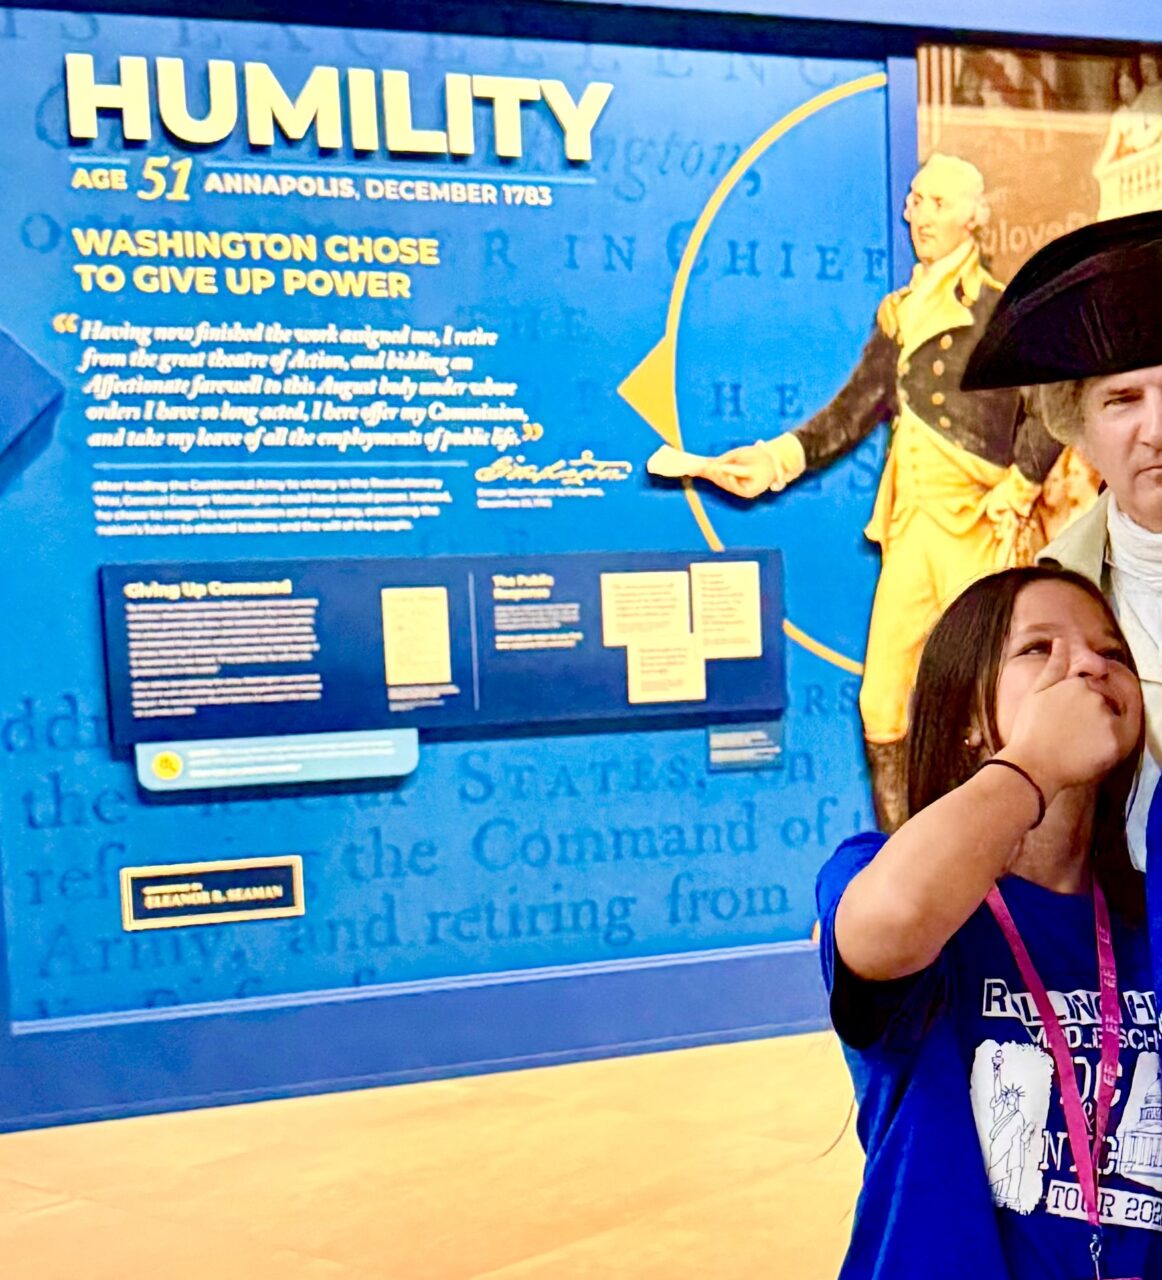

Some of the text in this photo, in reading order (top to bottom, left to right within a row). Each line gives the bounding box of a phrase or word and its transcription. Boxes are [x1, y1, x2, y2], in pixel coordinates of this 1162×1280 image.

[65, 53, 614, 161] HUMILITY
[72, 155, 553, 207] AGE 51 ANNAPOLIS, DECEMBER 1783
[72, 228, 318, 264] WASHINGTON
[325, 234, 441, 266] CHOSE
[73, 264, 411, 299] TO GIVE UP POWER
[190, 321, 264, 348] finished
[264, 322, 292, 343] the
[293, 323, 338, 343] work
[76, 346, 127, 373] from
[128, 347, 157, 368] the
[157, 350, 206, 373] great
[269, 348, 292, 374] of
[350, 349, 387, 370] and
[386, 350, 449, 376] bidding
[82, 373, 190, 400] Affectionate
[186, 374, 264, 400] farewell
[264, 377, 282, 394] to
[283, 375, 315, 395] this
[317, 375, 378, 401] August
[378, 375, 418, 402] body
[418, 376, 468, 397] under
[84, 400, 141, 421] orders
[155, 400, 200, 421] have
[219, 400, 259, 426] long
[360, 400, 400, 427] offer
[427, 401, 529, 423] Commission,
[87, 427, 127, 448] and
[126, 427, 166, 448] take
[166, 431, 196, 453] my
[196, 427, 244, 448] leave
[243, 426, 266, 453] of
[263, 426, 288, 448] all
[288, 426, 315, 447] the
[316, 427, 423, 453] employments
[423, 426, 446, 453] of
[439, 426, 490, 453] public
[124, 578, 293, 600] Giving Up Command
[492, 573, 516, 587] The
